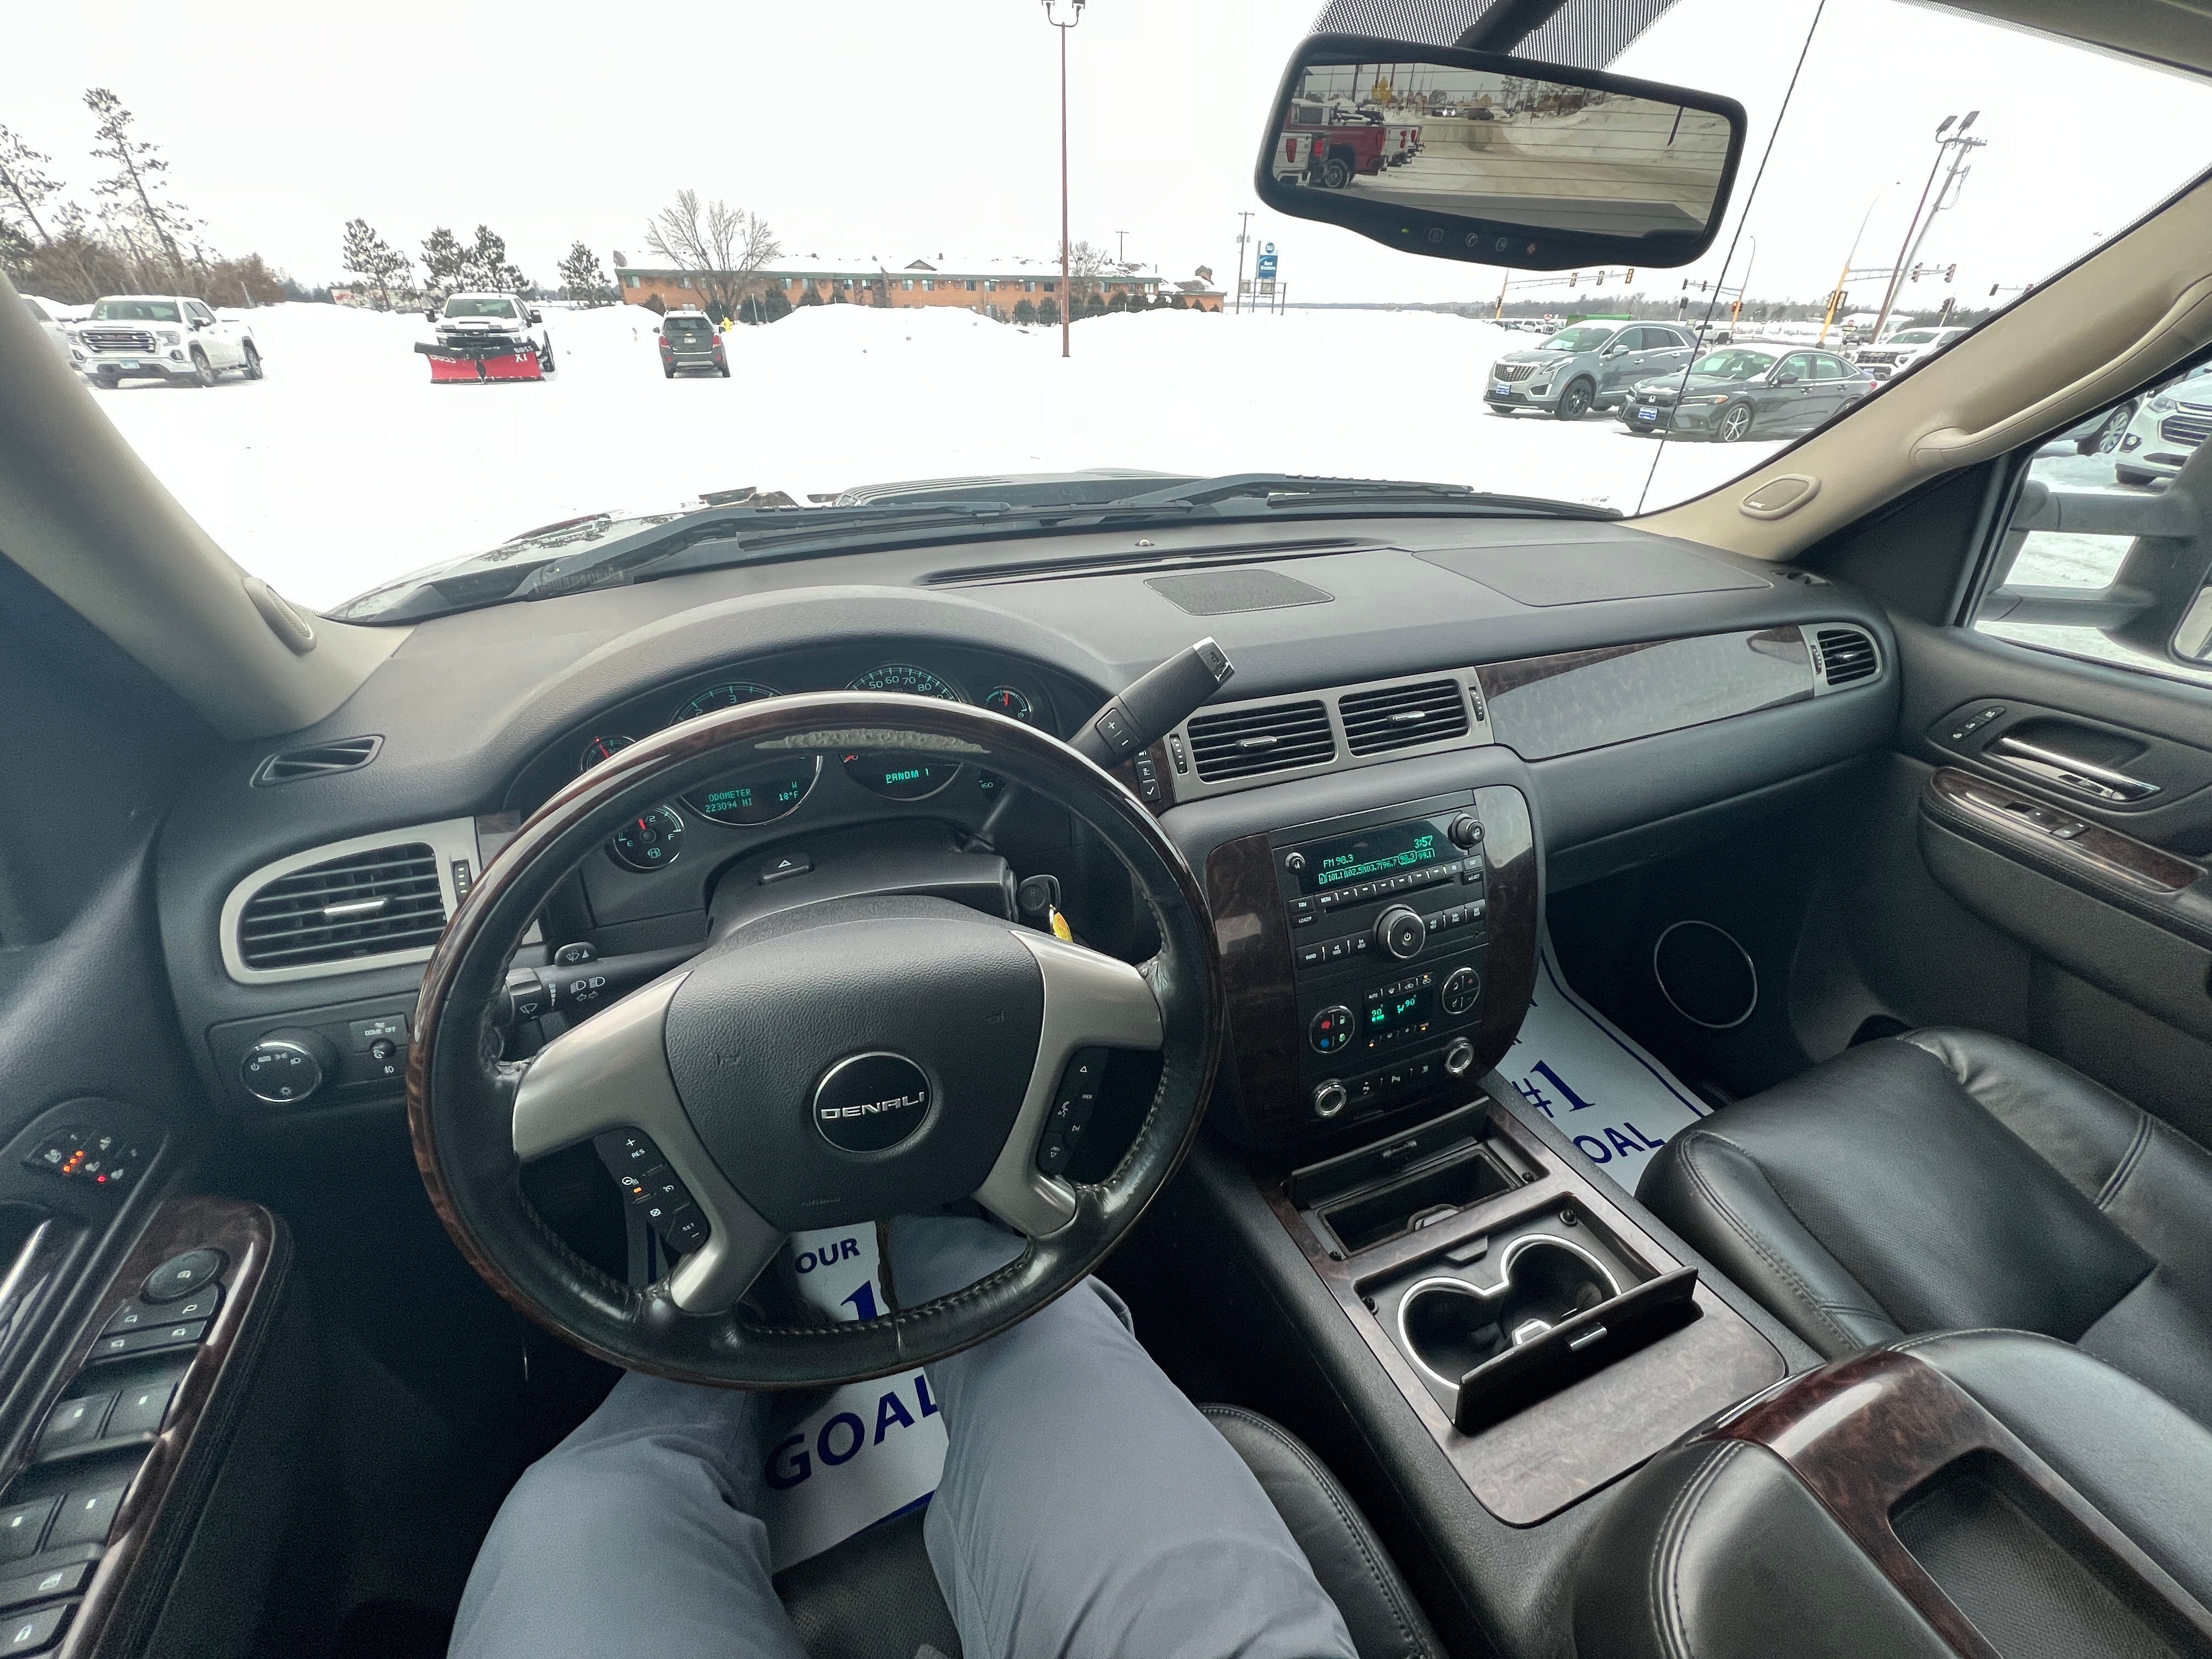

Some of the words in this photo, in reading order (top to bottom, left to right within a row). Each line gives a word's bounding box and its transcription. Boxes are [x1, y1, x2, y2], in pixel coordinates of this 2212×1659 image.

[868, 680, 883, 690] 50
[885, 675, 900, 685] 60
[903, 676, 916, 685] 70
[918, 684, 932, 692] 80
[729, 695, 737, 704] 3
[708, 788, 752, 802] ODOMETER
[778, 791, 799, 802] 18°F
[705, 802, 737, 813] 223094
[1414, 835, 1433, 849] 3:57
[1323, 859, 1334, 868] FM
[1335, 854, 1354, 866] 98.3
[1405, 998, 1415, 1007] 90
[1511, 1060, 1596, 1118] #1
[821, 1091, 925, 1119] DENALI
[1572, 1122, 1667, 1164] OAL
[631, 1149, 645, 1158] RES
[795, 1238, 860, 1274] OUR
[840, 1280, 878, 1322] 1
[765, 1374, 939, 1490] GOAL
